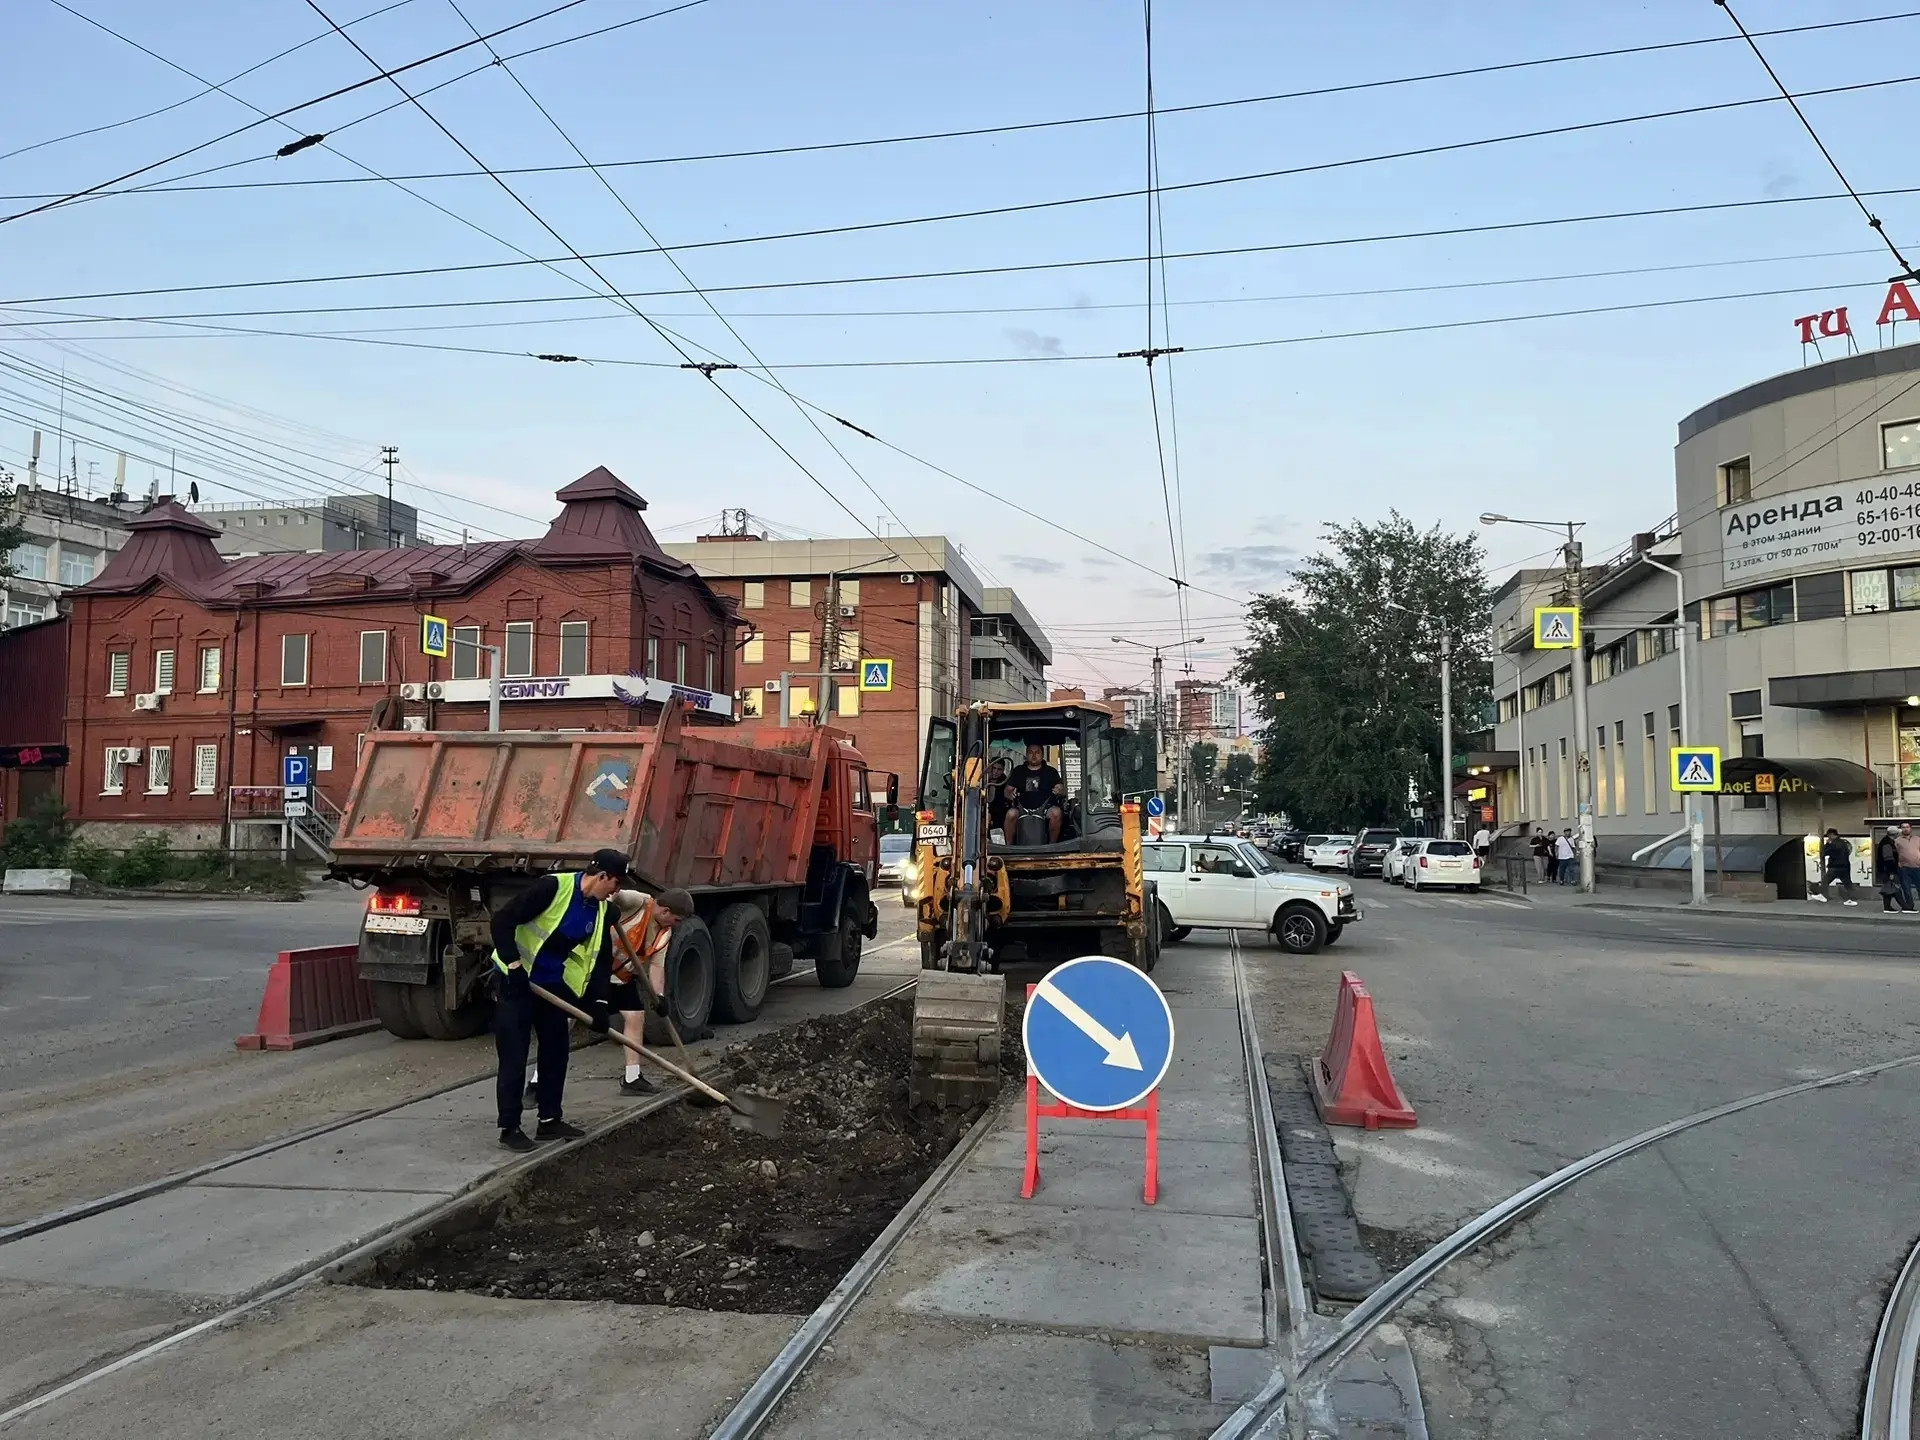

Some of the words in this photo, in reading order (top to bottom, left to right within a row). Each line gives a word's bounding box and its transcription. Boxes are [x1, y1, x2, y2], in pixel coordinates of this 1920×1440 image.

[1856, 482, 1920, 505] 40-40-48
[1727, 494, 1843, 536] Аренда
[1857, 503, 1920, 526] 65-16-16
[1742, 541, 1748, 549] в
[1750, 534, 1775, 547] этом
[1778, 525, 1821, 540] здании
[1730, 561, 1741, 570] 2,3
[1766, 551, 1779, 561] От
[1781, 548, 1792, 558] 50
[1794, 547, 1809, 556] до
[290, 760, 303, 782] P
[1757, 775, 1771, 785] 24
[1719, 781, 1752, 793] АФЕ
[922, 826, 944, 836] 0640
